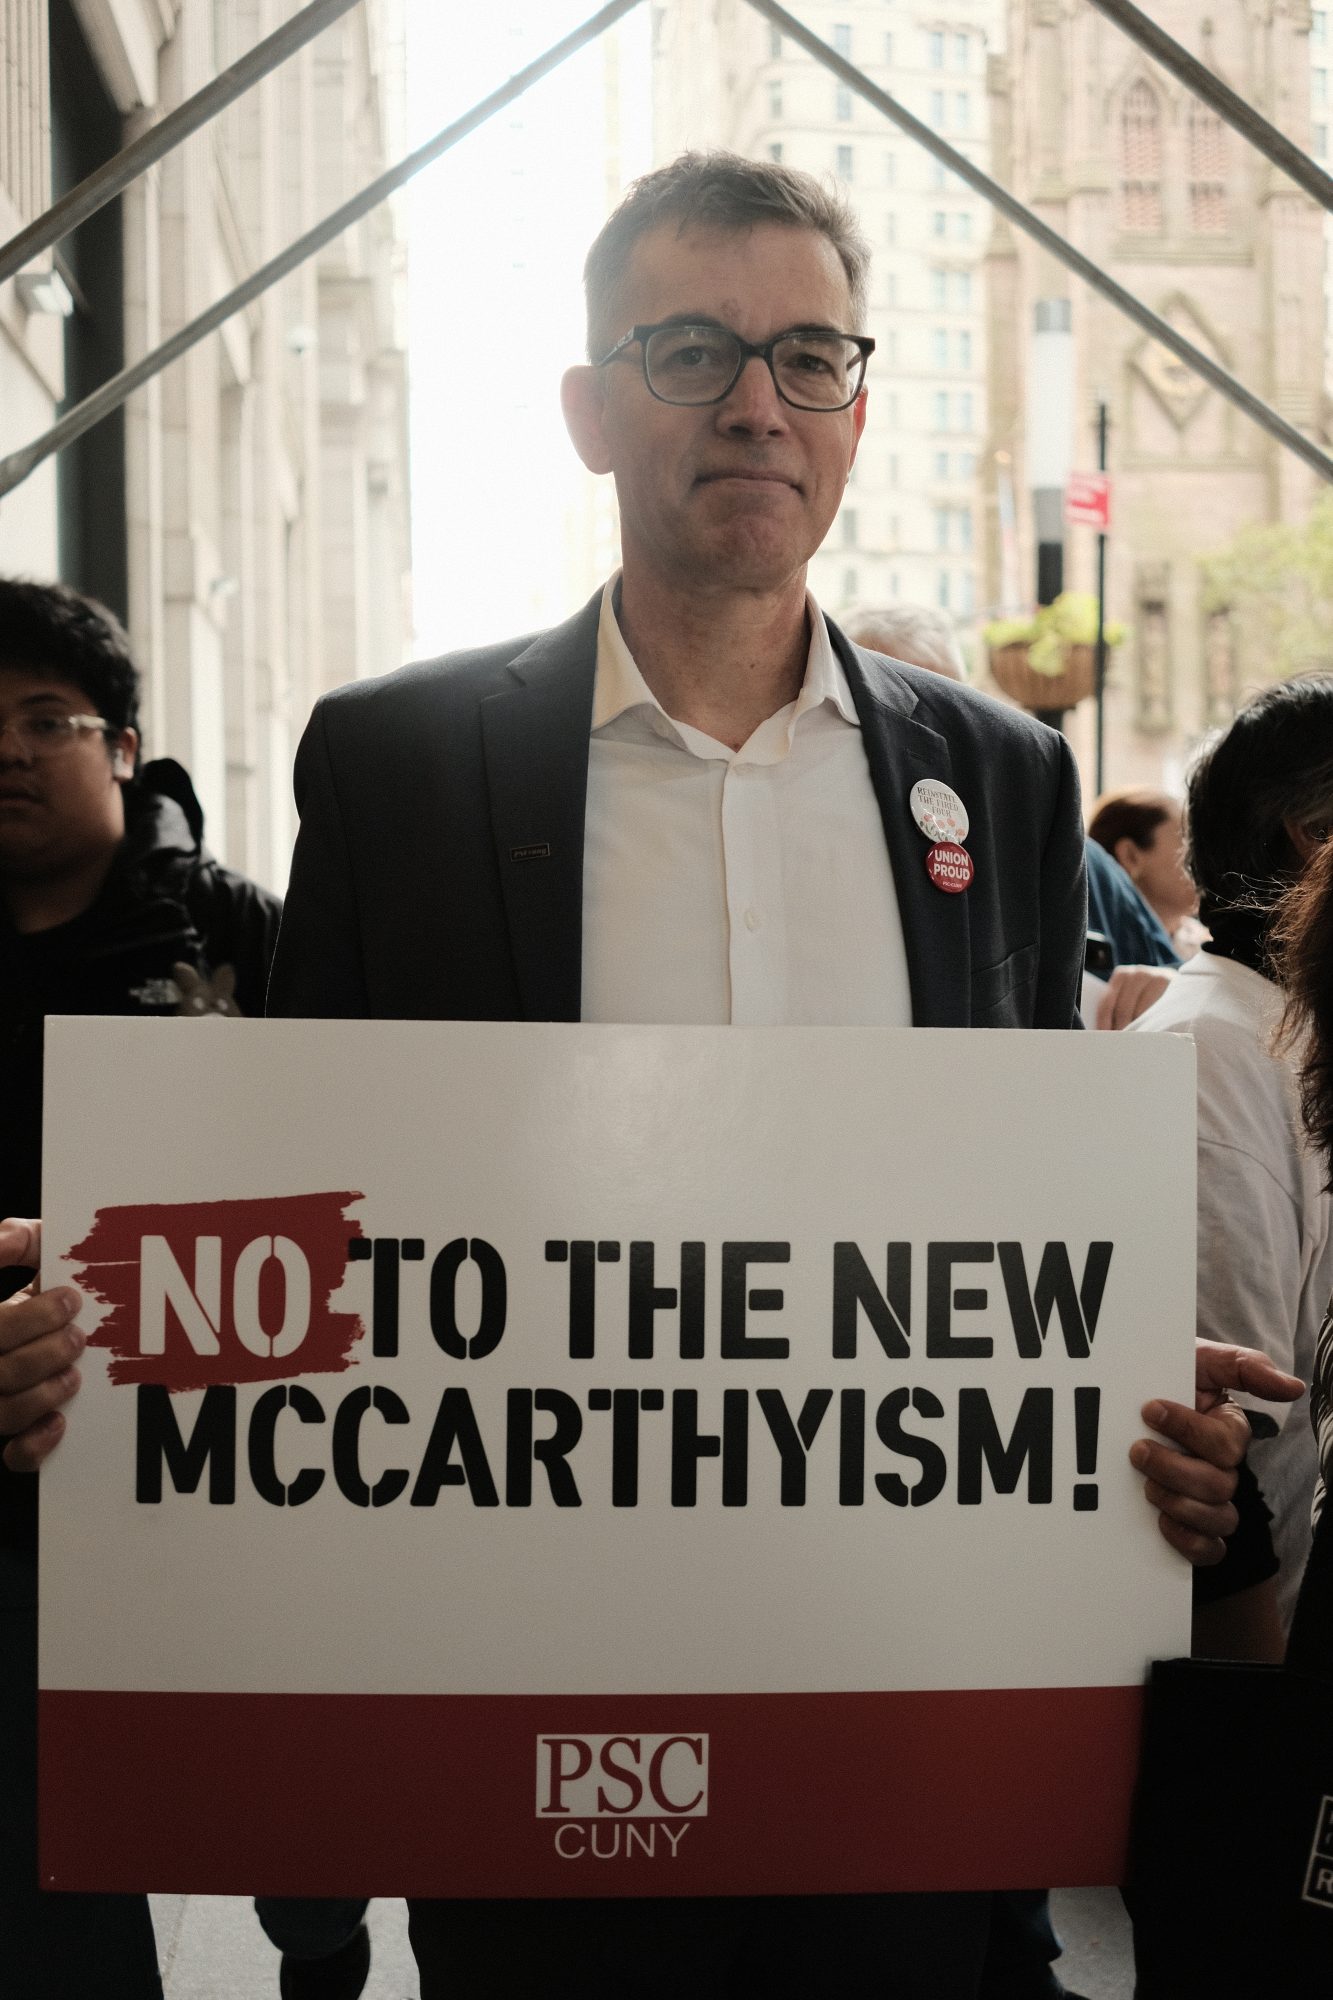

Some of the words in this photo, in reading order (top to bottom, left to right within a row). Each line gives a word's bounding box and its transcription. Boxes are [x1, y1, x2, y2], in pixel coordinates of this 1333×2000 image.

[917, 786, 958, 803] REINSTATE
[917, 794, 934, 805] THE
[936, 799, 959, 812] FIRED
[932, 806, 952, 818] FOUR
[934, 849, 969, 867] UNION
[933, 863, 970, 881] PROUD
[139, 1235, 311, 1358] NO
[347, 1236, 507, 1360] TO
[545, 1241, 791, 1360] THE
[832, 1241, 1115, 1360] NEW
[135, 1384, 1102, 1513] MCCARTHYISM!
[541, 1736, 704, 1814] PSC
[554, 1822, 691, 1859] CUNY
